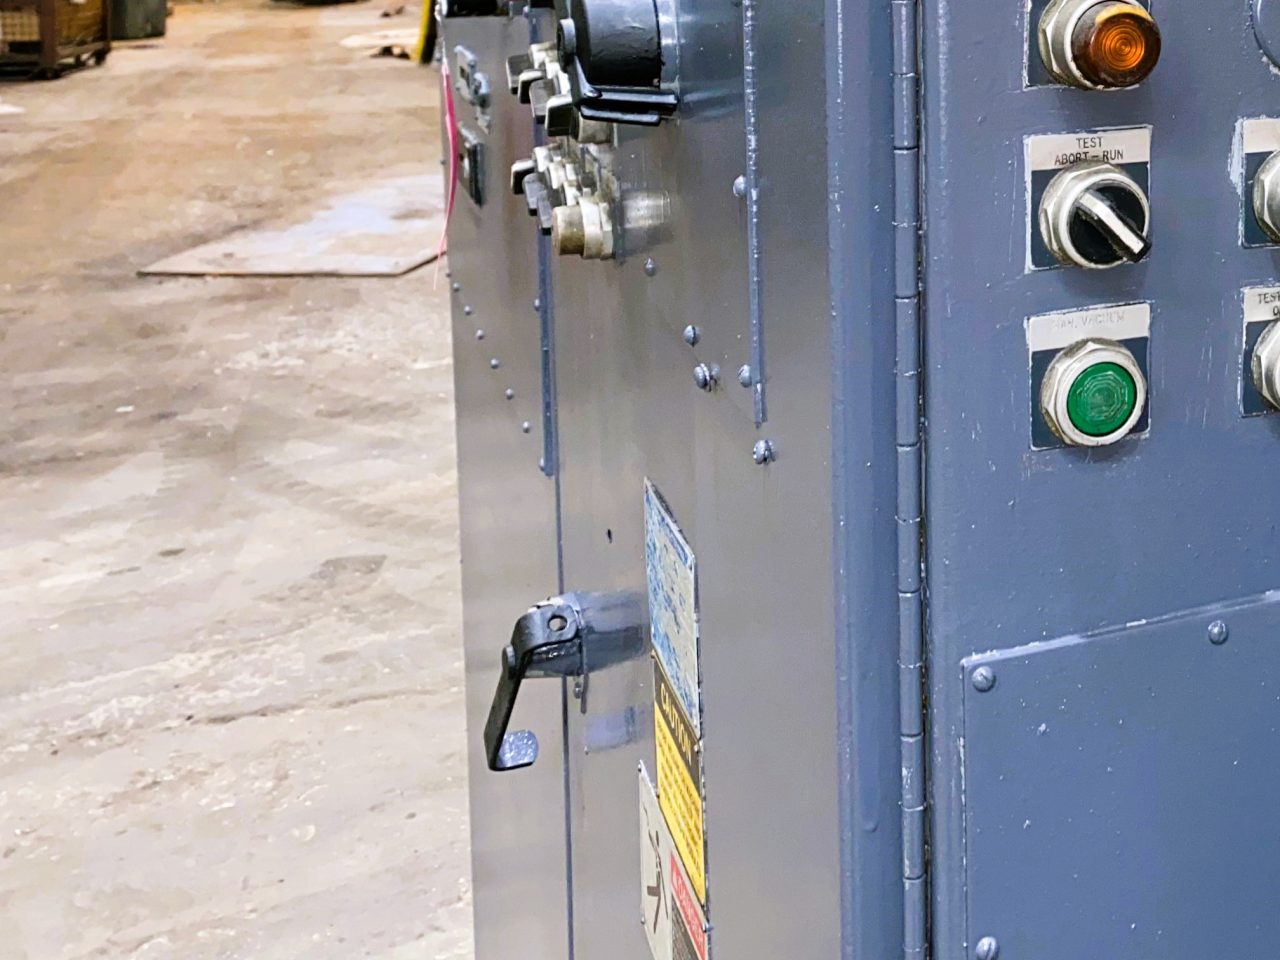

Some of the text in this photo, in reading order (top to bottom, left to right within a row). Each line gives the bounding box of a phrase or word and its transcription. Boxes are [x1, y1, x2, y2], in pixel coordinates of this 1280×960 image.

[1076, 137, 1104, 149] TEST
[1054, 152, 1090, 166] ABORT
[1102, 150, 1124, 162] RUN
[661, 683, 692, 767] CAUTION
